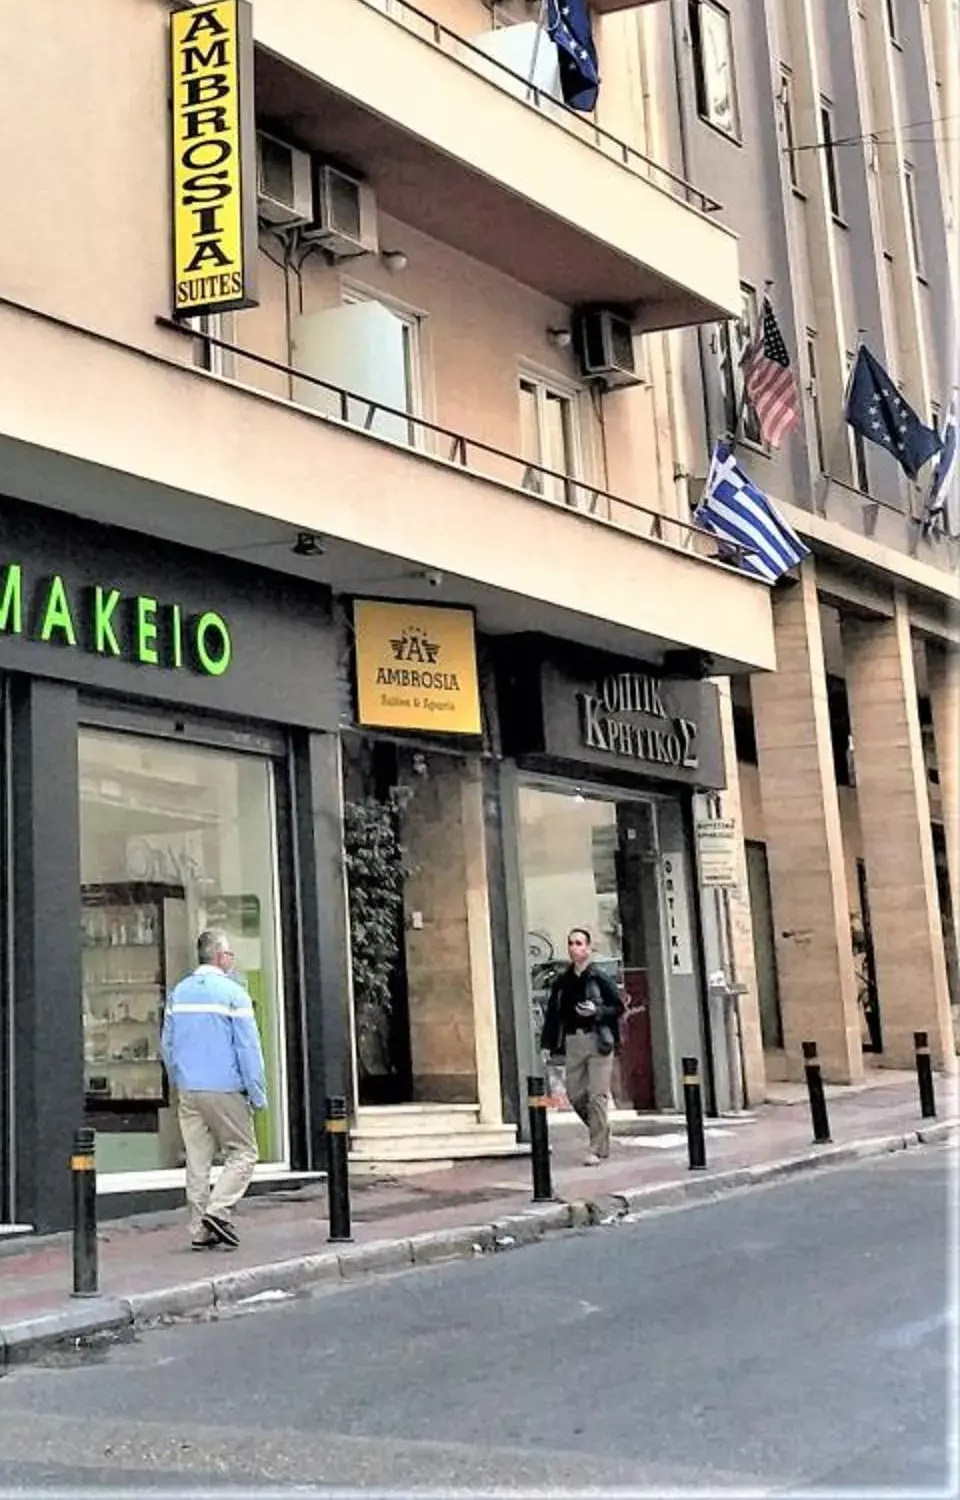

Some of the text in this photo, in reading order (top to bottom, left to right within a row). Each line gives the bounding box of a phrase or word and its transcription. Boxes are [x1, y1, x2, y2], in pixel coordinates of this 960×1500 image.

[179, 8, 234, 273] AMBROSIA
[177, 271, 242, 303] SUITES
[375, 667, 460, 691] AMBROSIA
[583, 693, 699, 770] ΚΡΗΤΙΚΟΣ
